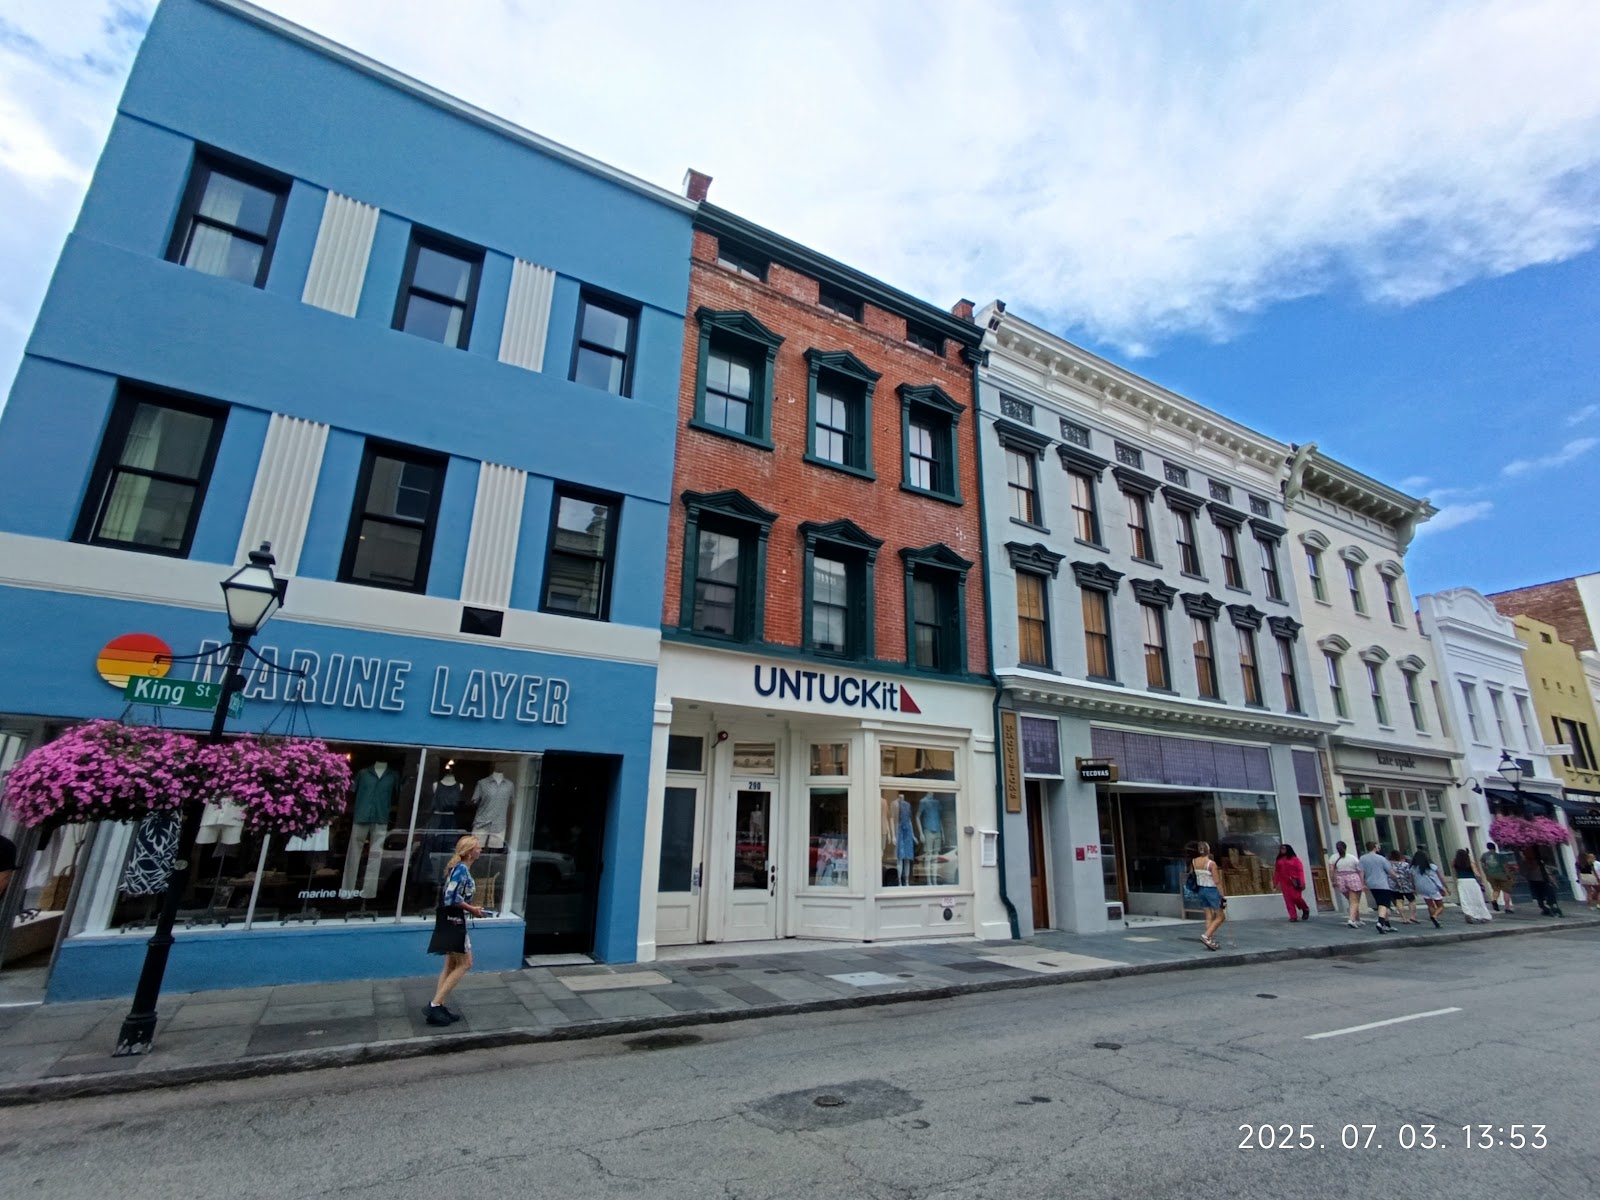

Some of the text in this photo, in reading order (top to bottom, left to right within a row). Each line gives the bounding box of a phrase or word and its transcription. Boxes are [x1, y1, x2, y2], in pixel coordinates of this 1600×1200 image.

[134, 679, 210, 705] King St
[191, 640, 569, 724] MARINE LAYER
[755, 665, 898, 711] UNTUCKit
[1376, 751, 1416, 771] kate spade
[748, 781, 761, 790] 290
[298, 888, 364, 900] marine layer
